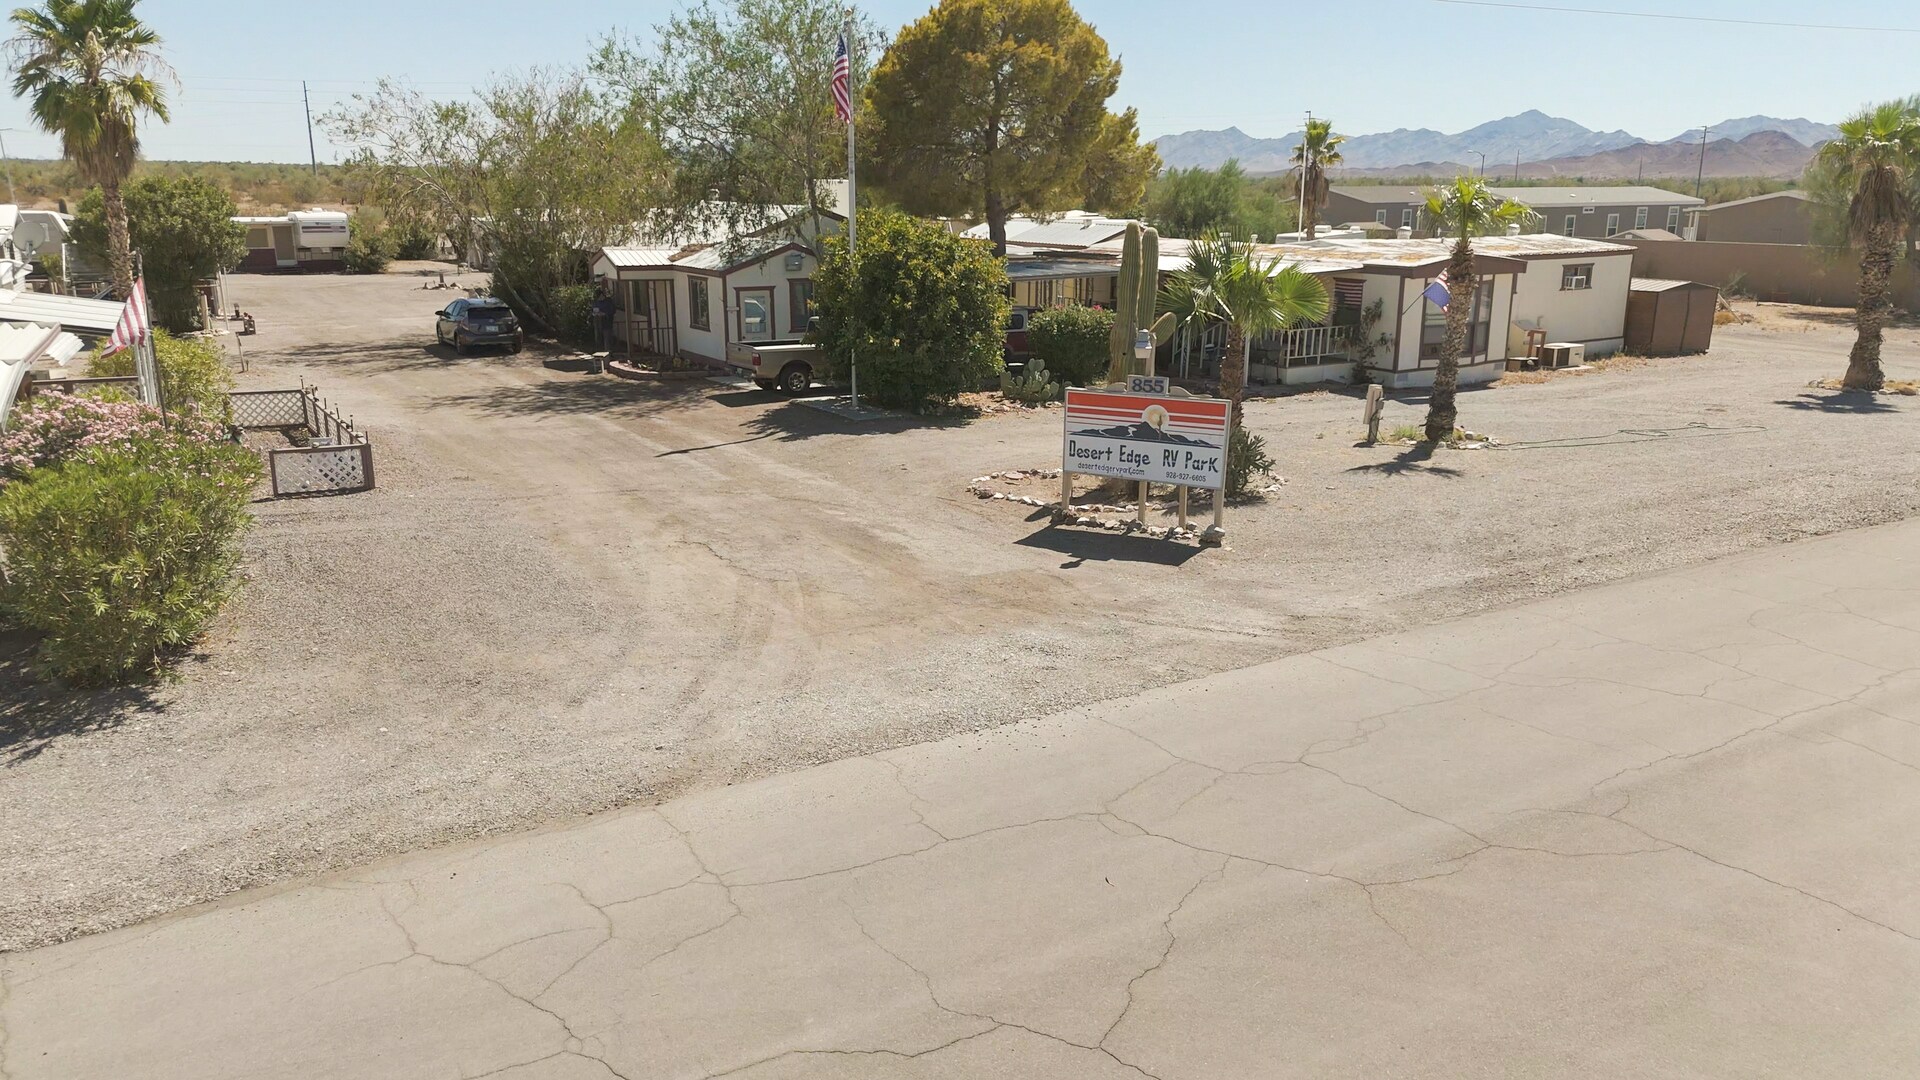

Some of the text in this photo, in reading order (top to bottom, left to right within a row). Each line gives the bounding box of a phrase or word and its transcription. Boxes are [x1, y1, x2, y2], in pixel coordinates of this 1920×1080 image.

[1132, 378, 1164, 394] 855
[1069, 440, 1113, 461] Desert
[1119, 444, 1151, 468] Edge
[1163, 448, 1180, 467] RV
